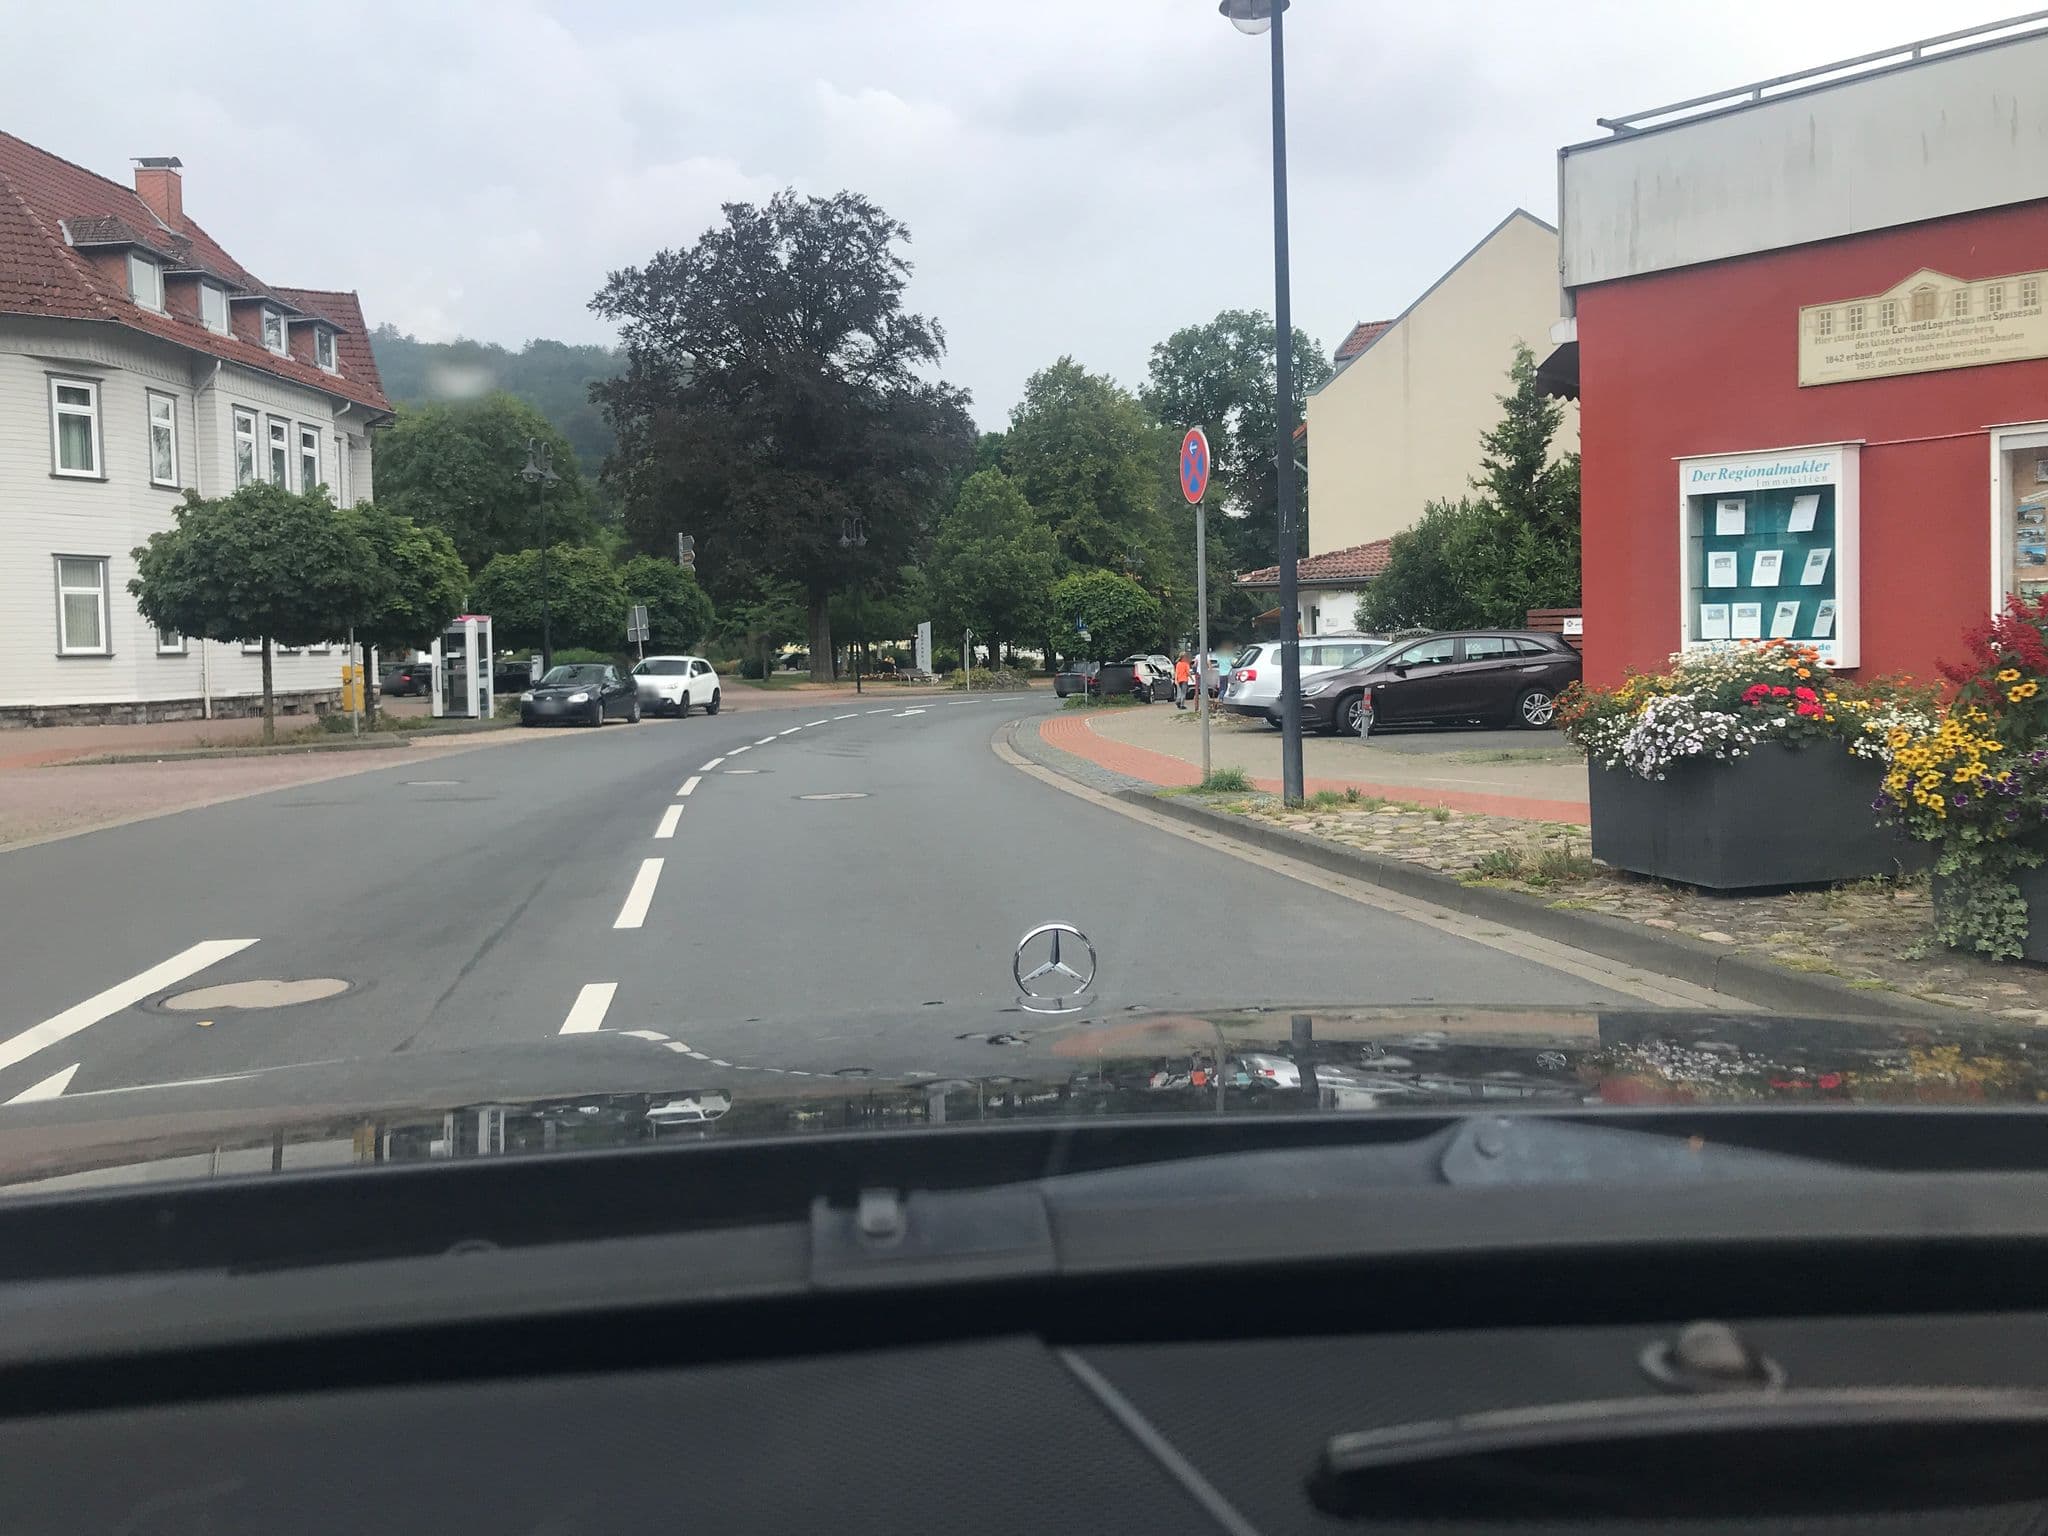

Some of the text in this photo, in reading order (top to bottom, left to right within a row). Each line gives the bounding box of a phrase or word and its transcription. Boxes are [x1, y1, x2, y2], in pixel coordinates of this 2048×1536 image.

[1992, 305, 2042, 322] Speisesaal
[1855, 340, 1870, 349] des
[1825, 353, 1845, 364] 1842
[1914, 342, 1935, 352] nach
[1878, 358, 1896, 368] dem
[1692, 460, 1830, 482] Der Regionalmakler
[1756, 475, 1827, 487] Immobilien
